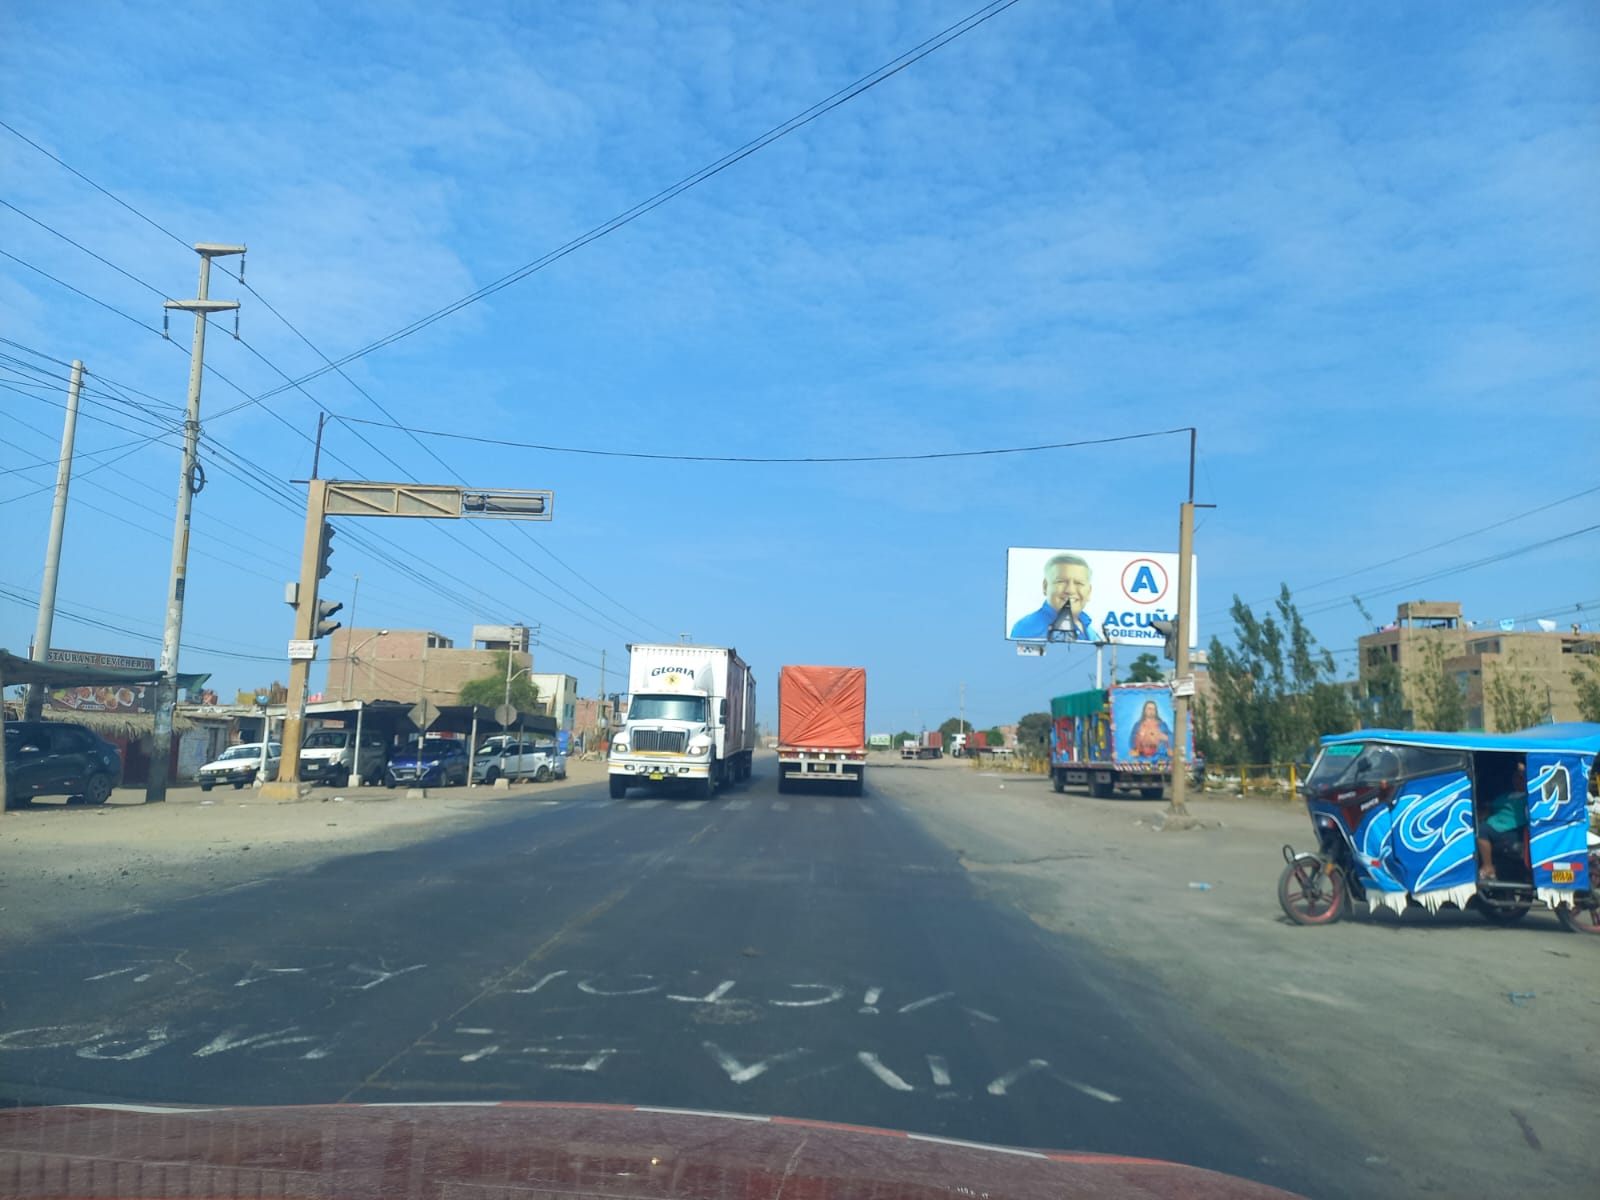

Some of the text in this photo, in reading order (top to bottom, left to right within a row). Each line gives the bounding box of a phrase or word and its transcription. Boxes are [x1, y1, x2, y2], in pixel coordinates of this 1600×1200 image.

[1130, 565, 1159, 593] A
[1103, 608, 1179, 628] ACUÑ
[47, 650, 97, 664] STAURANT
[651, 666, 695, 681] GLORIA
